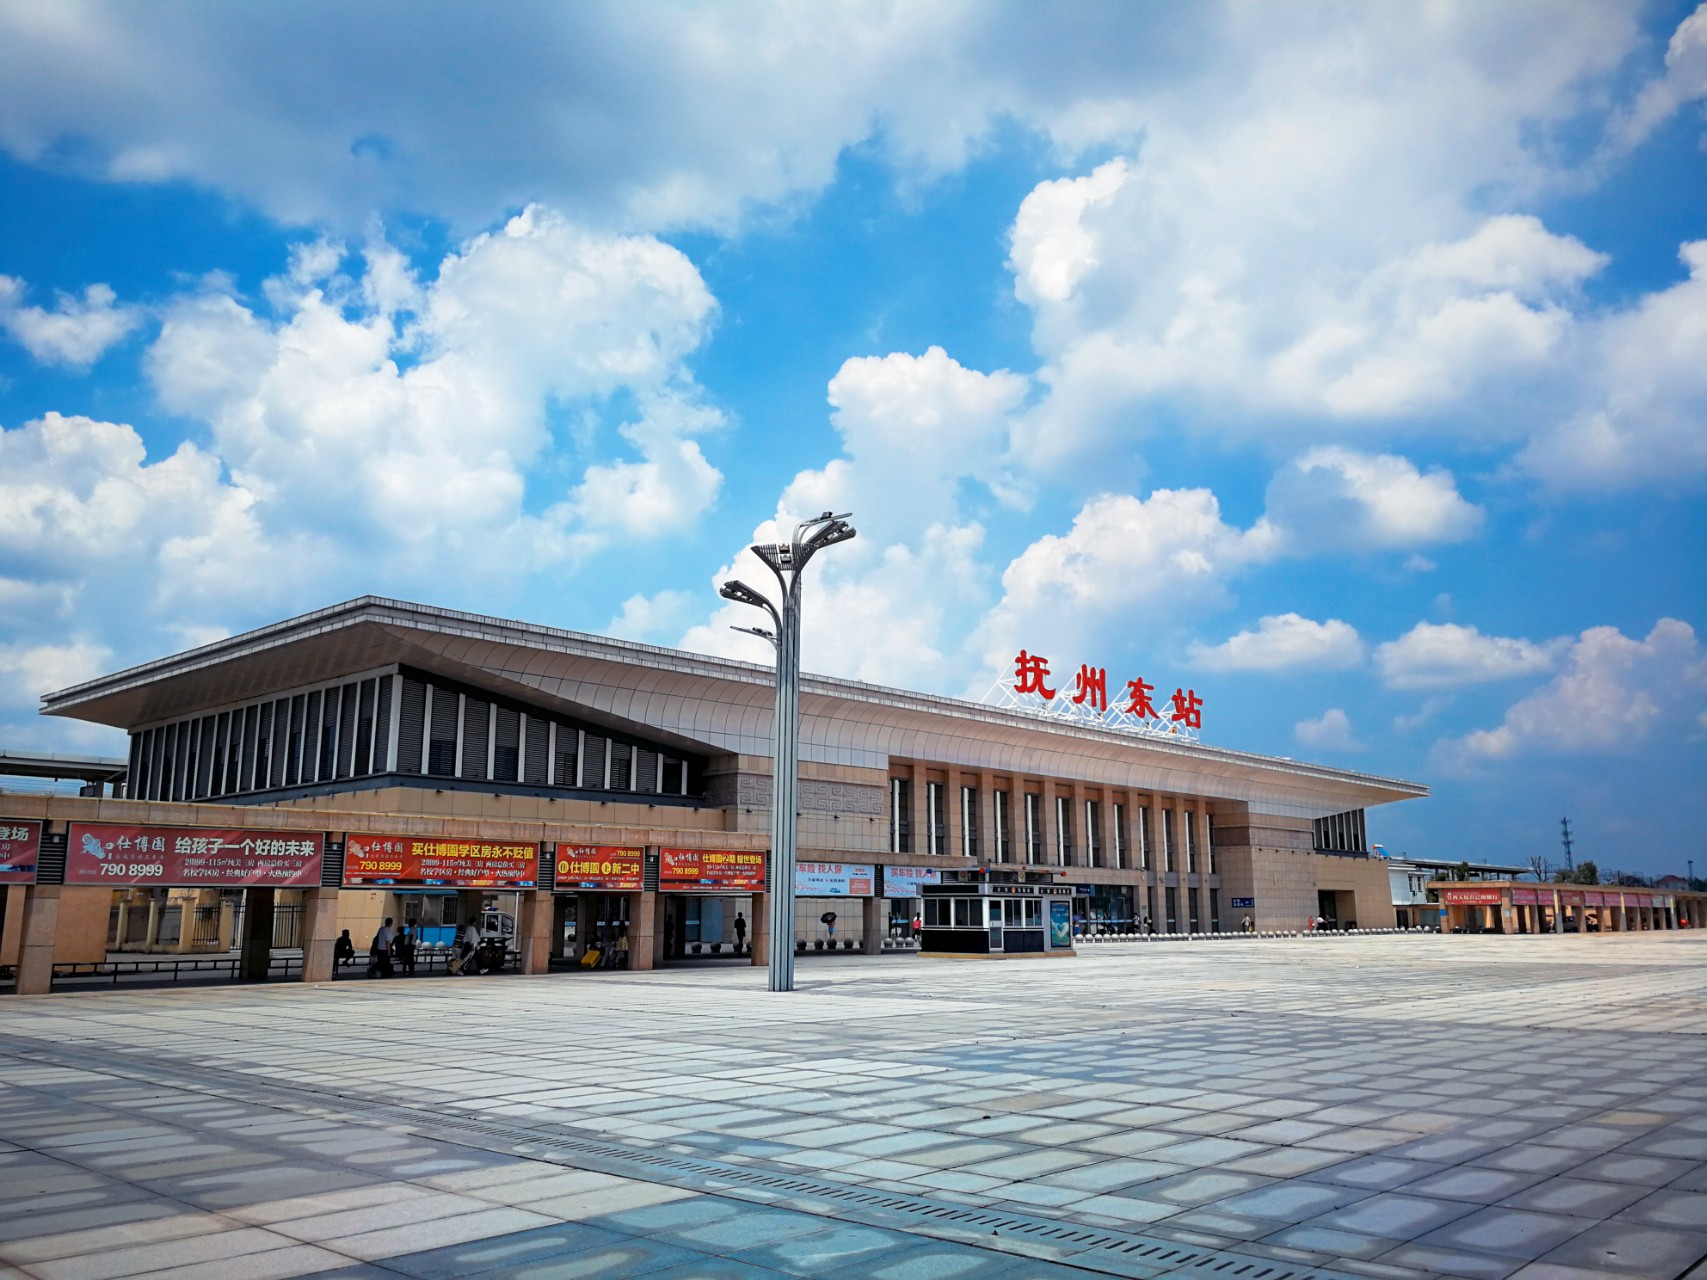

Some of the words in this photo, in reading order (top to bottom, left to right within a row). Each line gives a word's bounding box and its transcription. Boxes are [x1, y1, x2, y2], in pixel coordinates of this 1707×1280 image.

[1014, 649, 1203, 729] 抚州东站
[175, 837, 314, 856] 给孩子一个好的未来
[100, 863, 125, 876] 790
[129, 864, 163, 876] 8999
[360, 861, 377, 870] 790
[379, 862, 402, 870] 8999
[672, 867, 684, 875] 790
[818, 864, 842, 874] 找人保
